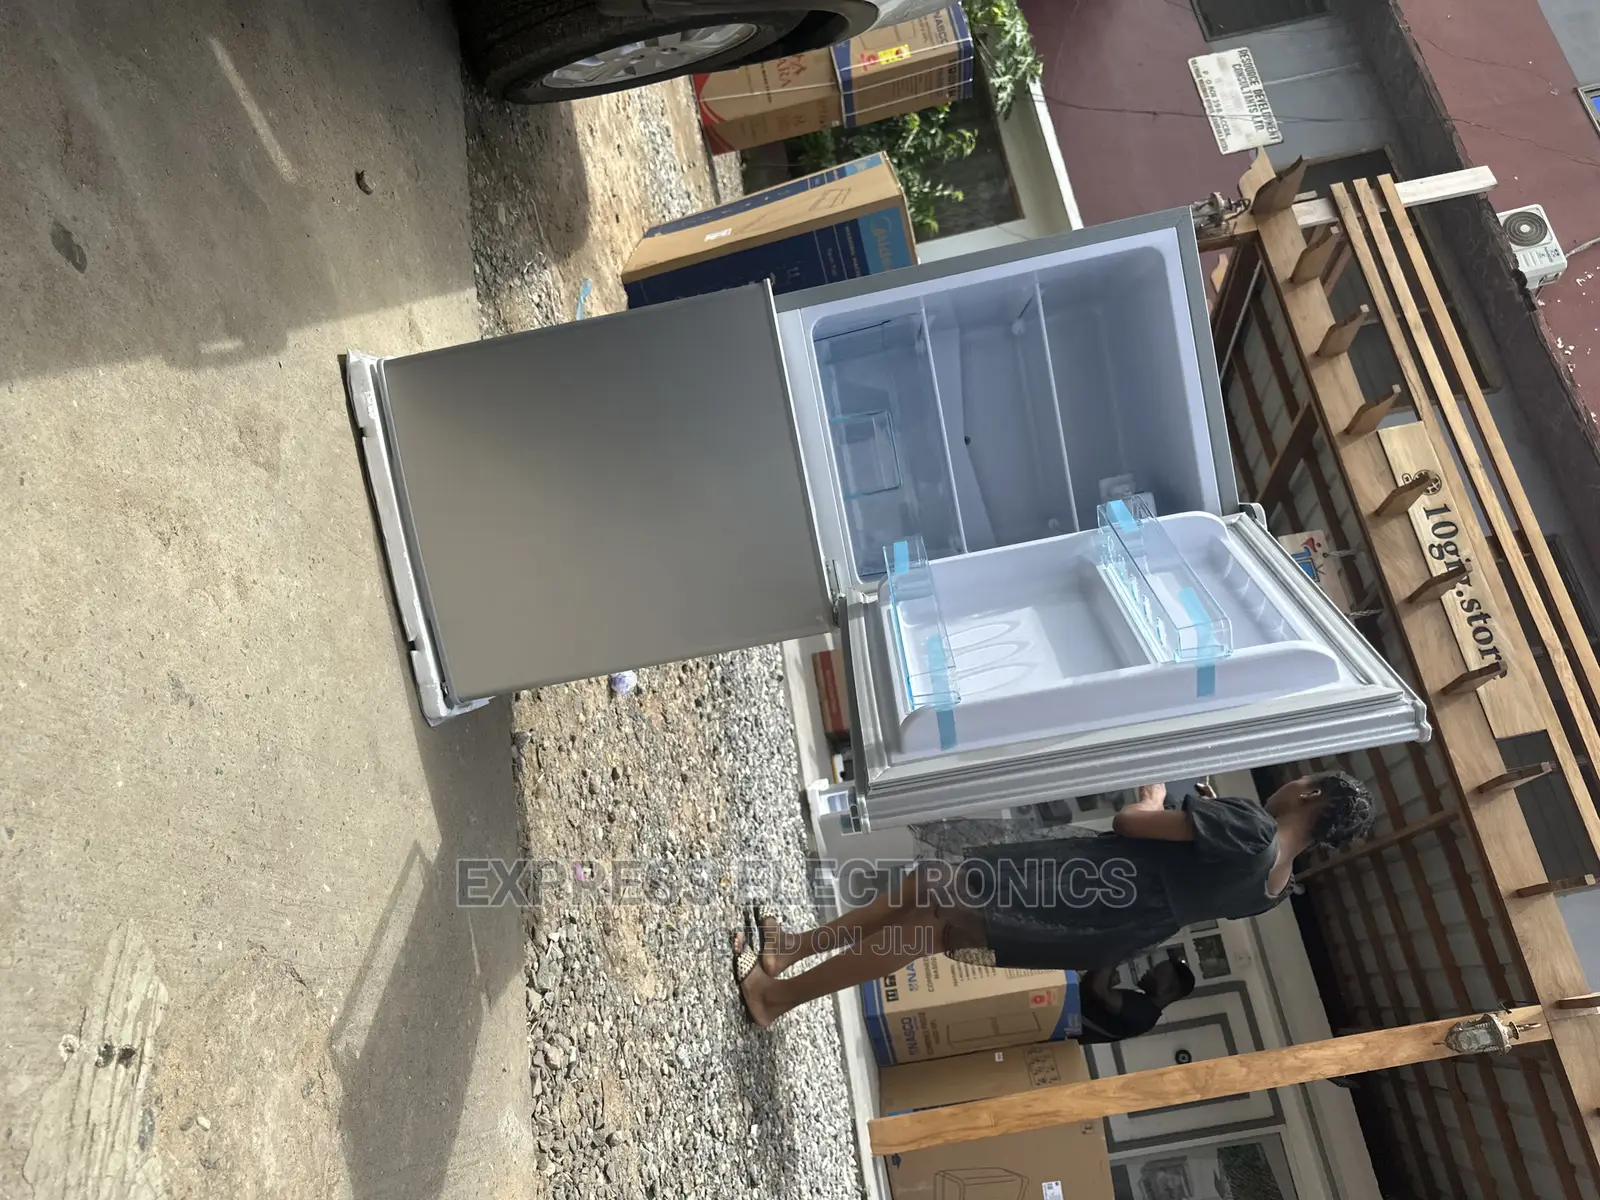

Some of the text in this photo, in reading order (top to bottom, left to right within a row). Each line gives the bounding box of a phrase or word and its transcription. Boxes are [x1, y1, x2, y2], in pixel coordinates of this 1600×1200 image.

[1232, 63, 1259, 113] CONSULTANTS
[1238, 49, 1280, 141] RESOURCE DEVELOPMENT
[901, 1017, 918, 1054] NASCO
